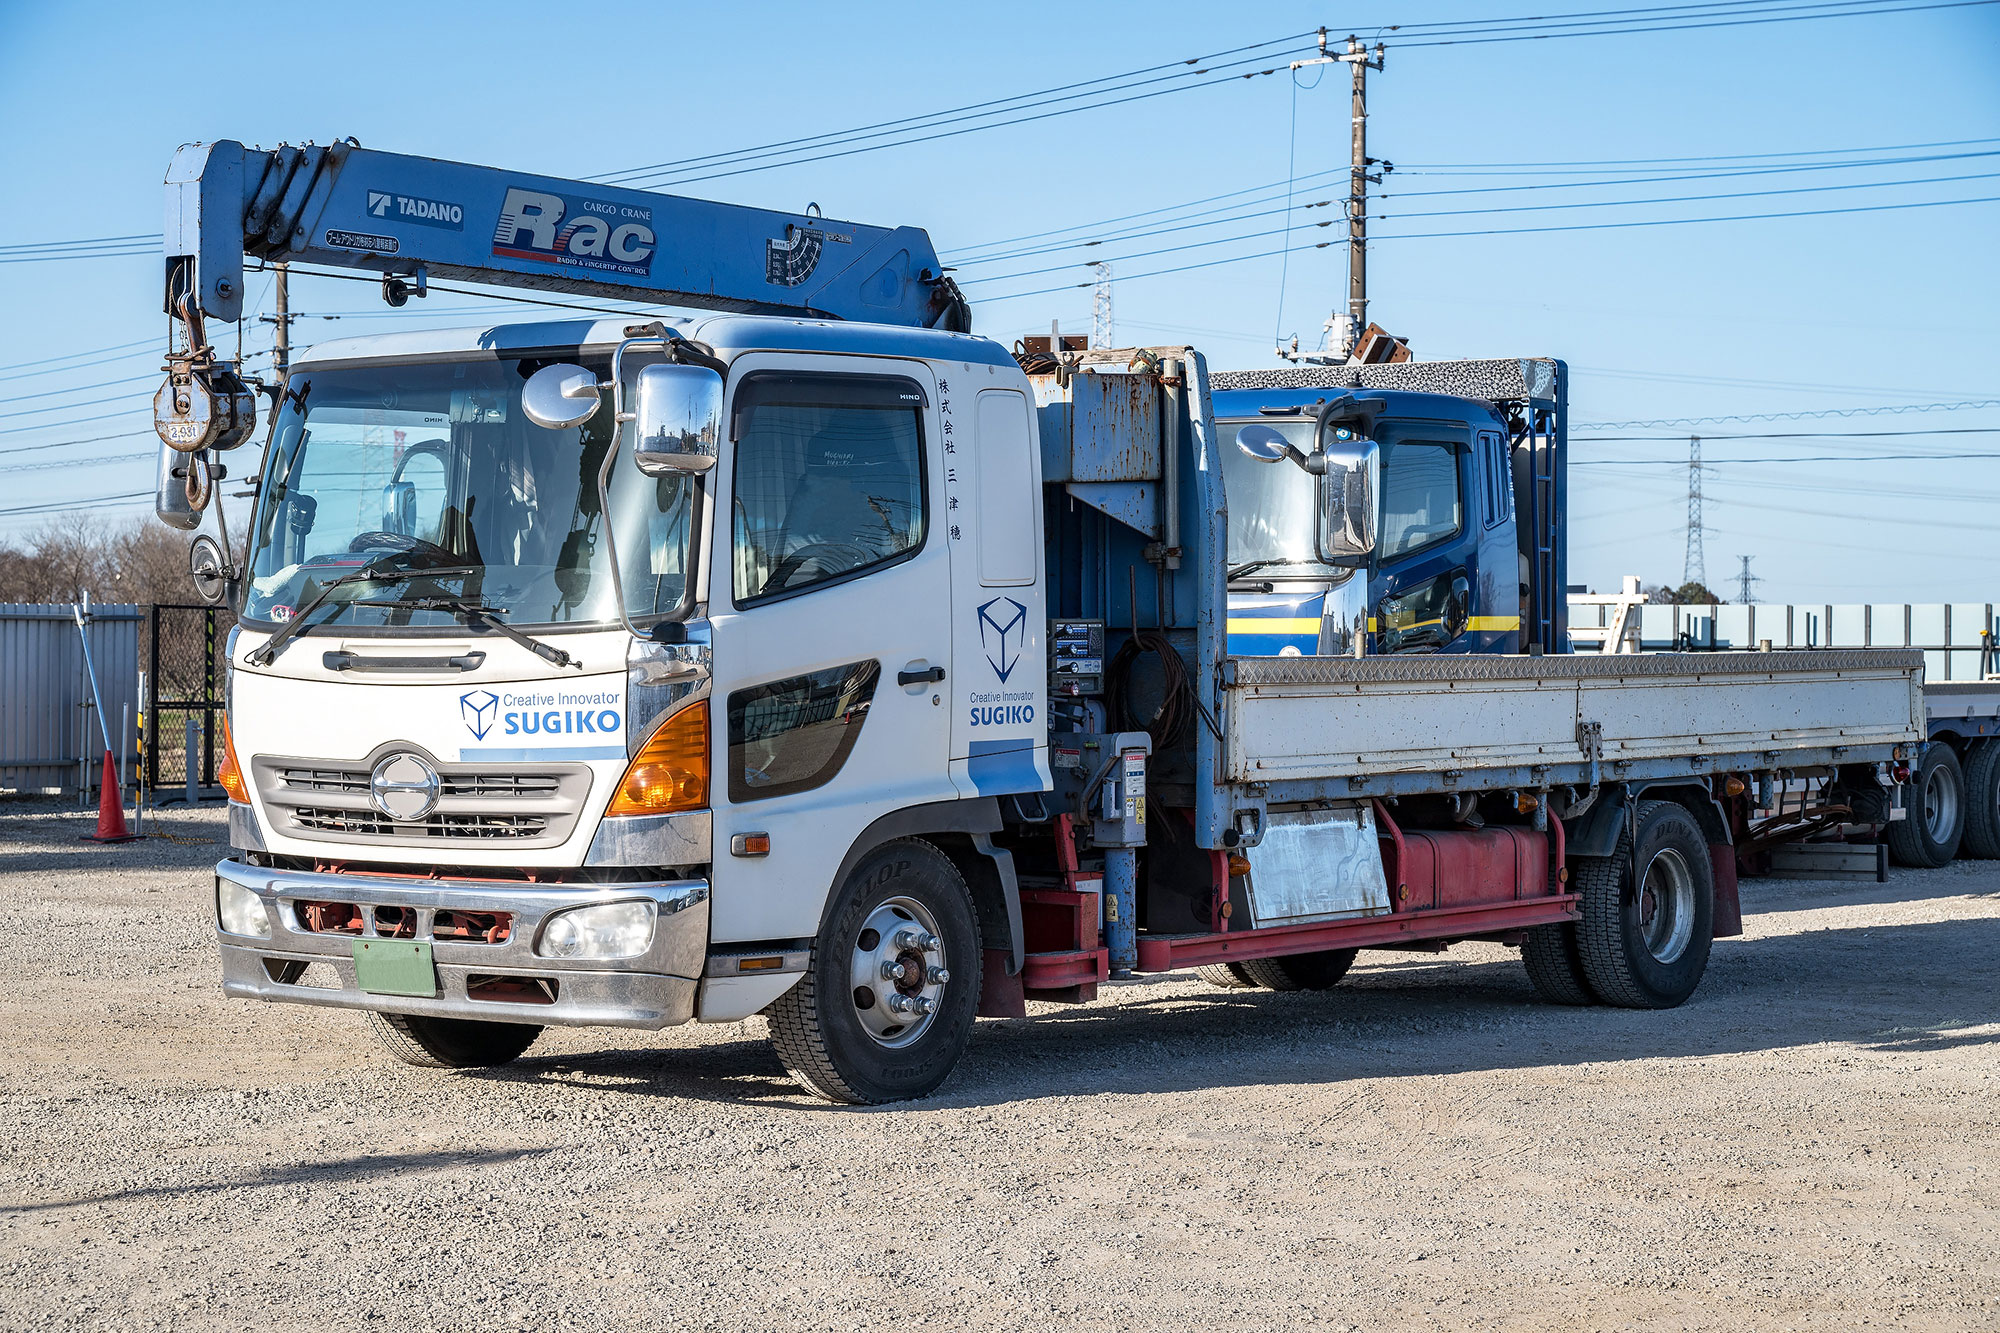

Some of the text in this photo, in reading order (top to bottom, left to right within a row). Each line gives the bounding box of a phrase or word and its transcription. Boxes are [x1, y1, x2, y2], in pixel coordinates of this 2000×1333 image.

[397, 197, 462, 223] TADANO
[584, 201, 651, 220] CARGO CRANE
[494, 188, 654, 262] Rac
[556, 256, 578, 266] RADIO
[585, 261, 617, 270] FINGERTIP
[503, 693, 620, 707] Creative Innovator
[970, 690, 1034, 704] Creative Innovator
[505, 710, 621, 735] SUGIKO
[970, 705, 1035, 727] SUGIKO
